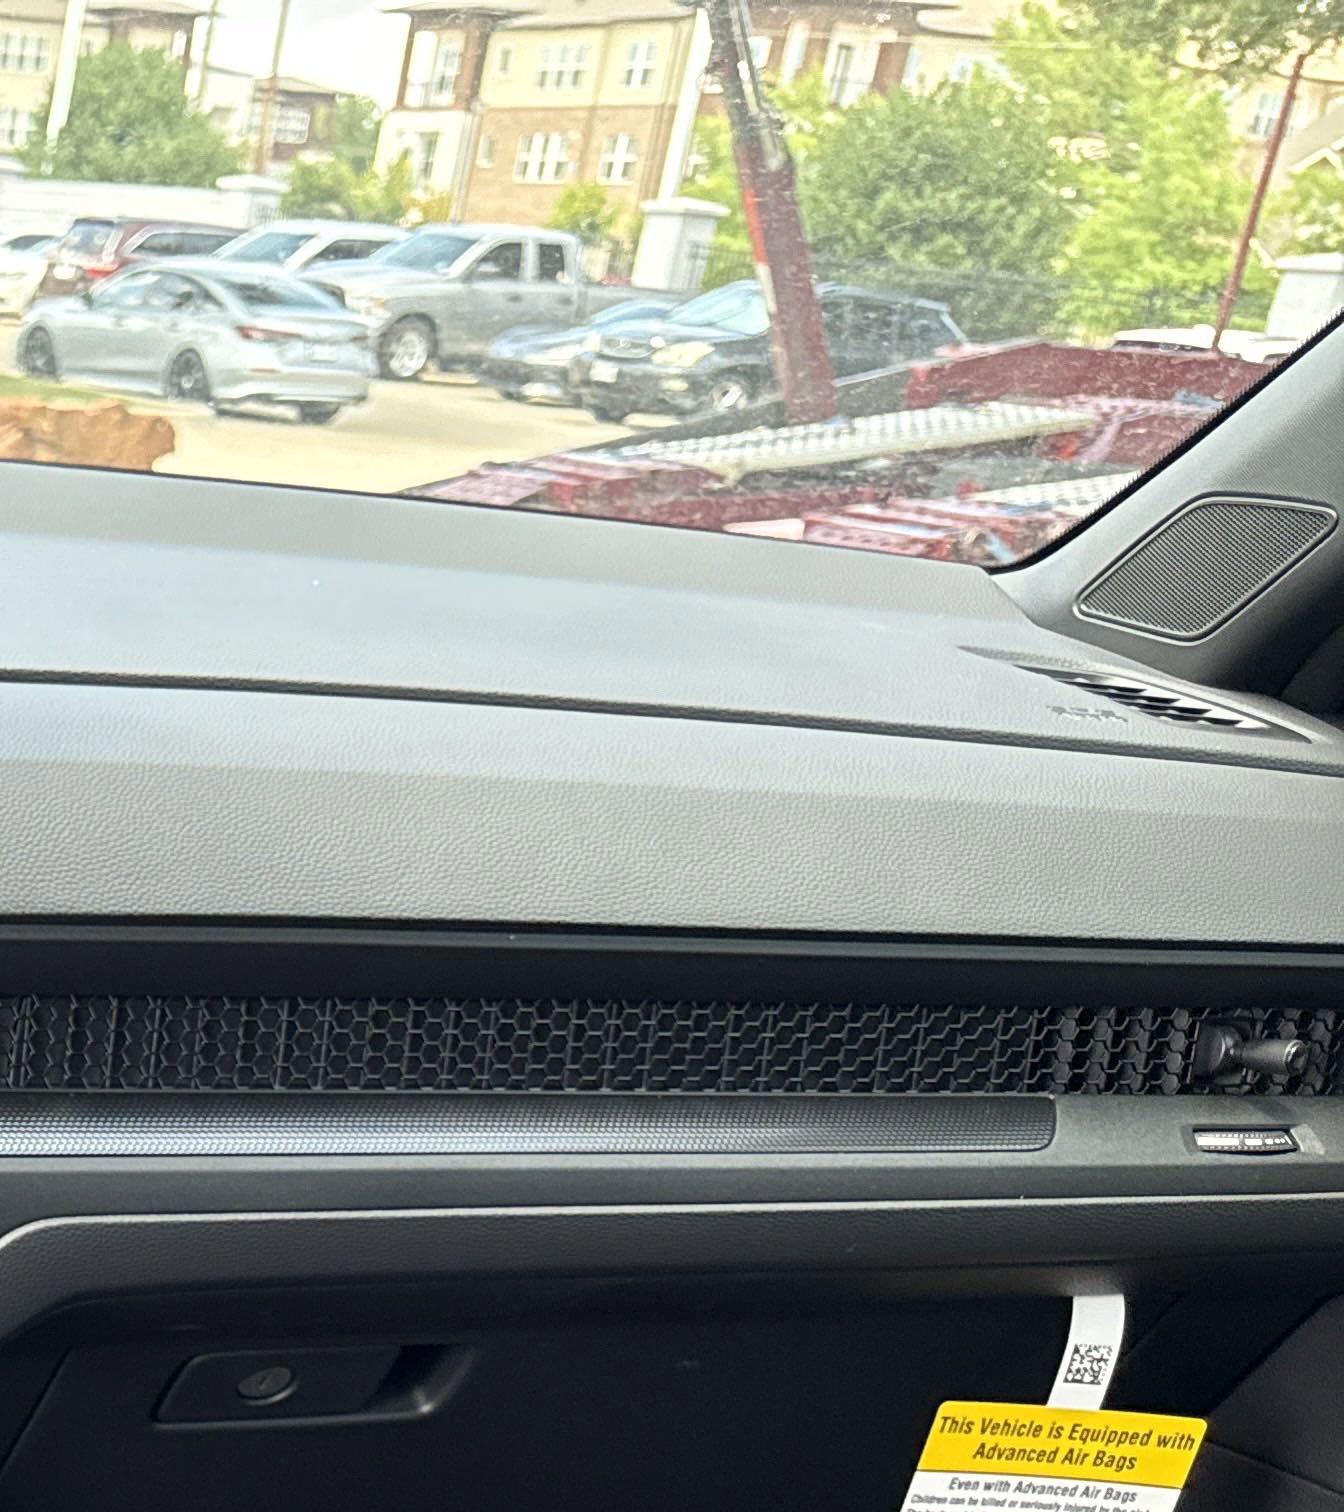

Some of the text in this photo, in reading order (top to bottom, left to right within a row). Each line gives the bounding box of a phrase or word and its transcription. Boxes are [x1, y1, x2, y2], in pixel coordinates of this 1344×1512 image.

[939, 1416, 1196, 1451] This Vehicle is Equipped with
[972, 1442, 1137, 1472] Advanced Air Bags
[910, 1494, 947, 1504] Children
[949, 1496, 965, 1505] can
[967, 1496, 978, 1506] be
[1008, 1500, 1018, 1508] or
[1020, 1499, 1061, 1512] seriously
[948, 1477, 1137, 1504] Even with Advanced Air Bags
